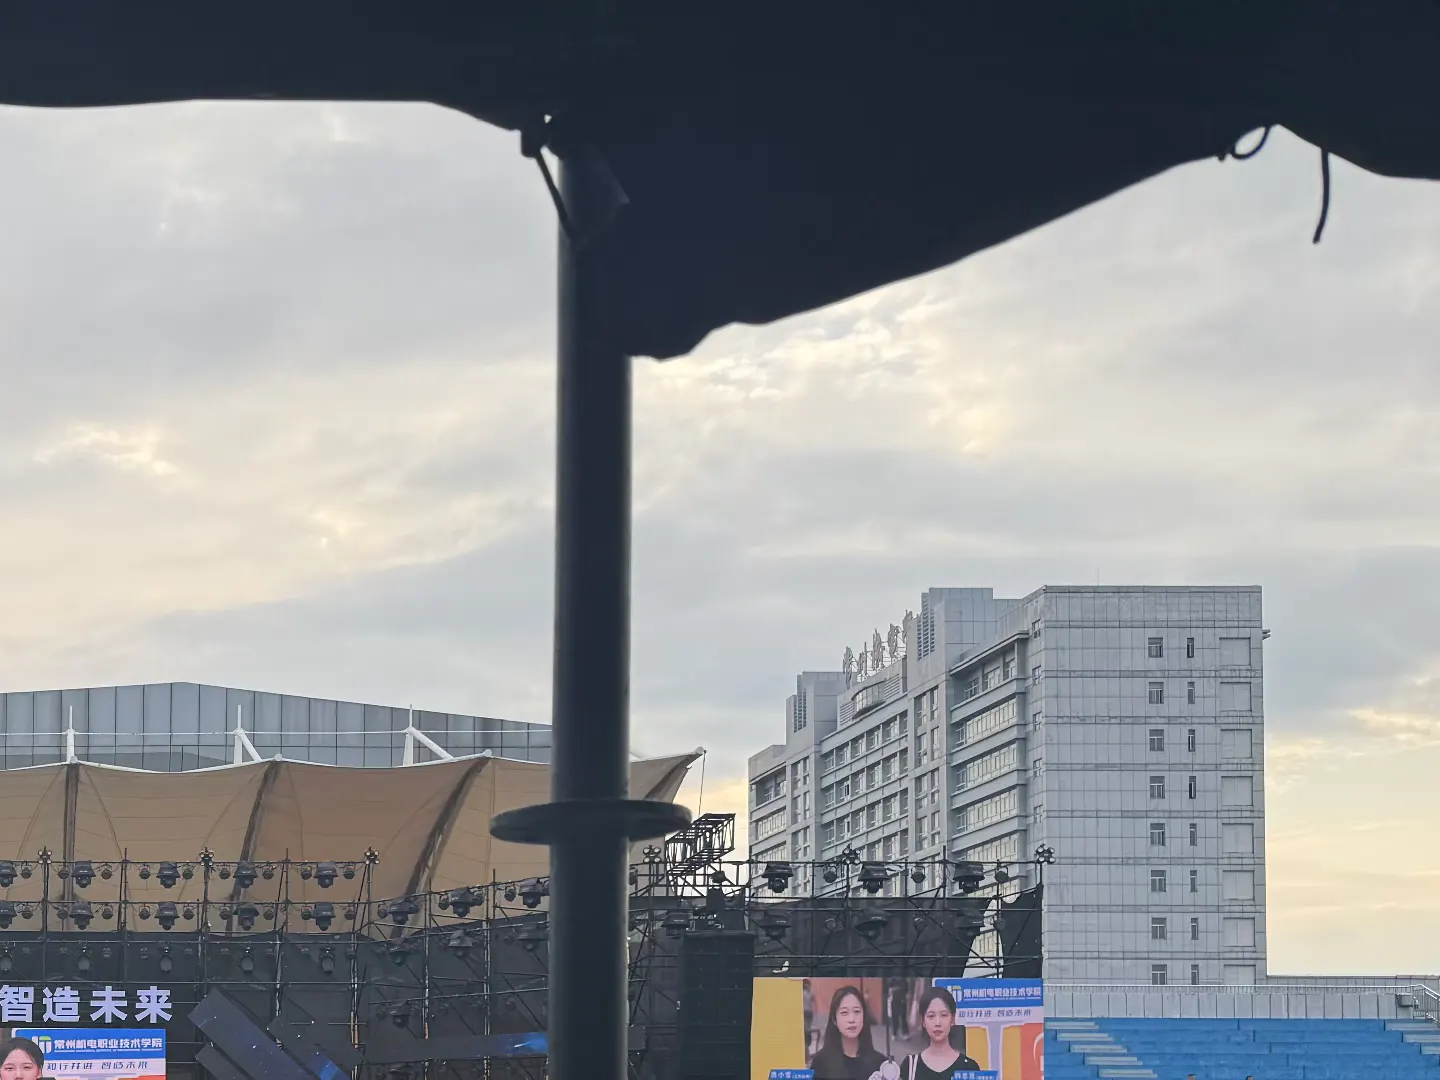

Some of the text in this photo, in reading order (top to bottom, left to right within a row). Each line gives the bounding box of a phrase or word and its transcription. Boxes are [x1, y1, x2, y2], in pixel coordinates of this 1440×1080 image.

[53, 1037, 163, 1050] 常州机电职业技术学院
[46, 1062, 93, 1071] 知行并进
